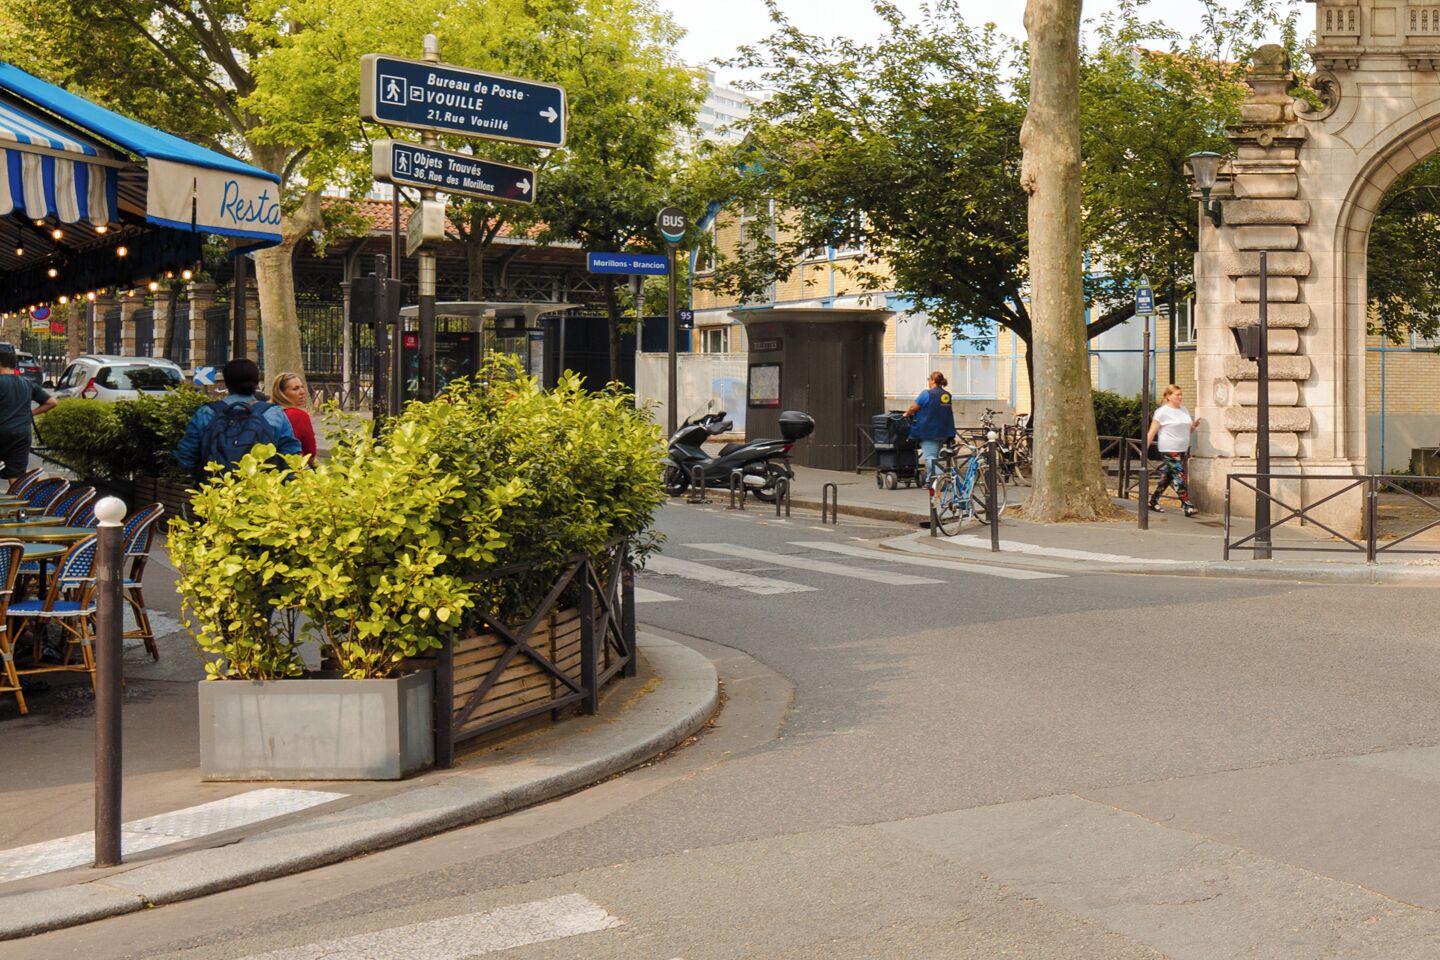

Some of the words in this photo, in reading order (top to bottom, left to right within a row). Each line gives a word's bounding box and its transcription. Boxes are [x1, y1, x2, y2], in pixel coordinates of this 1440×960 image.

[427, 73, 470, 91] Bureau
[473, 82, 488, 94] de
[491, 84, 524, 100] Poste
[427, 91, 483, 110] VOUILLE
[444, 111, 465, 124] Rue
[471, 115, 509, 131] Vouillé
[413, 152, 443, 169] Objets
[448, 159, 482, 176] Trouvés
[428, 170, 442, 182] Rue
[446, 174, 459, 185] des
[462, 177, 495, 192] Morillons
[221, 180, 281, 225] Resta
[662, 215, 684, 227] BUS
[593, 260, 628, 268] Morillons
[632, 261, 665, 269] Brancion
[680, 312, 691, 320] 95
